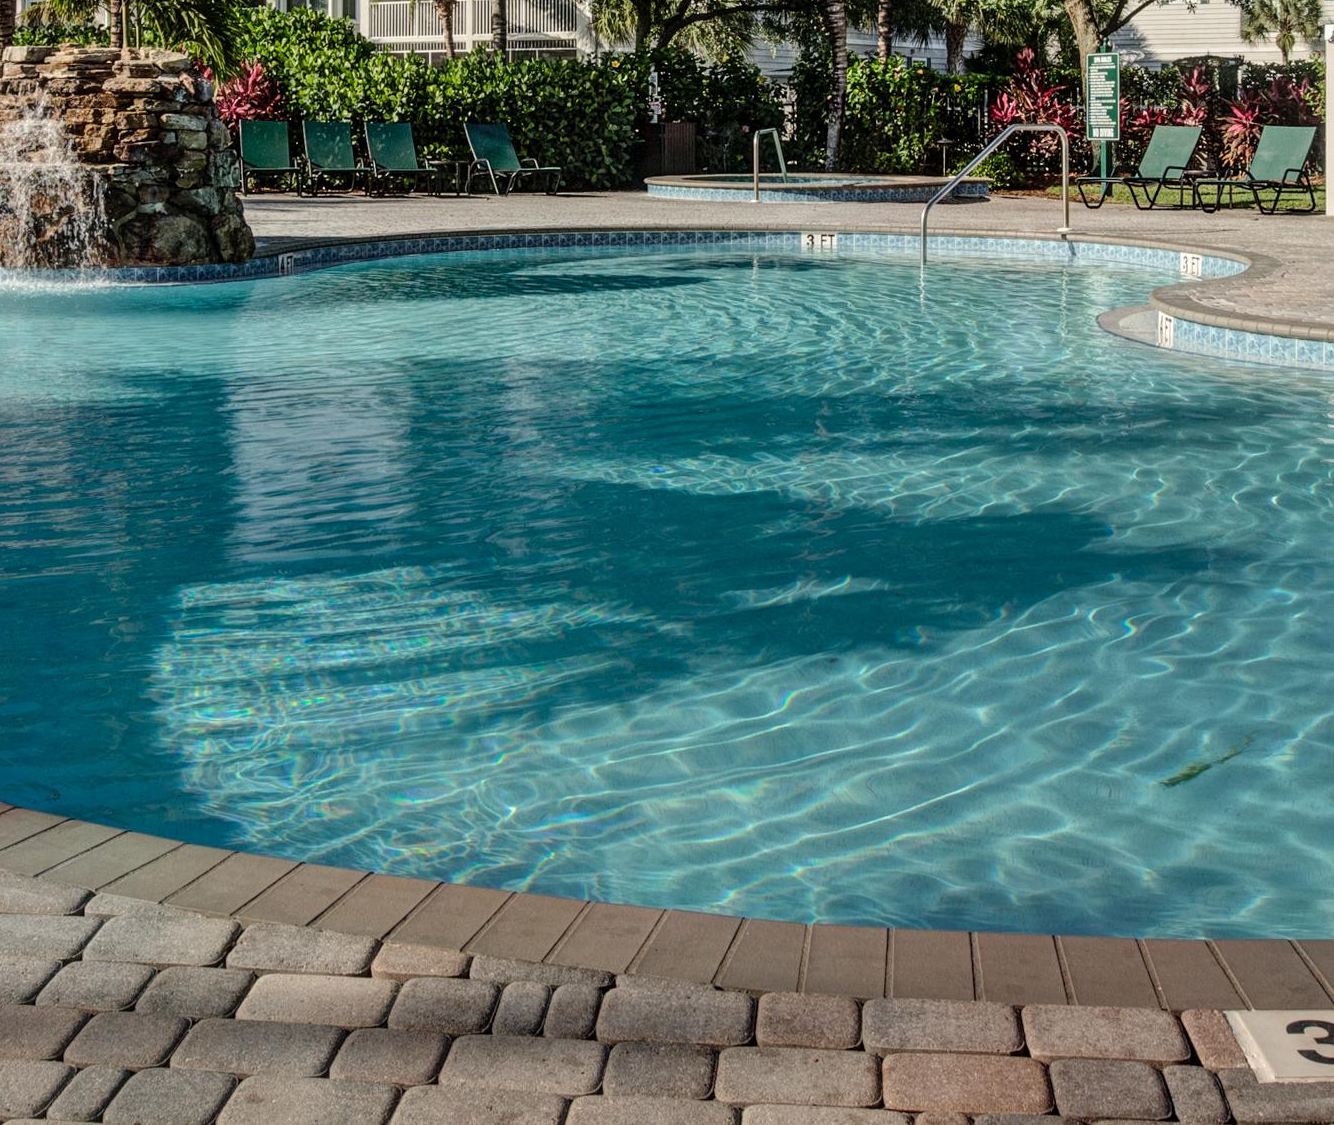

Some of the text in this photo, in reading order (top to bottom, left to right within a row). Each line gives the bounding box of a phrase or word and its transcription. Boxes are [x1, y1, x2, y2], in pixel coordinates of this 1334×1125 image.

[1100, 128, 1114, 138] DIVING
[806, 234, 835, 248] 3 FT
